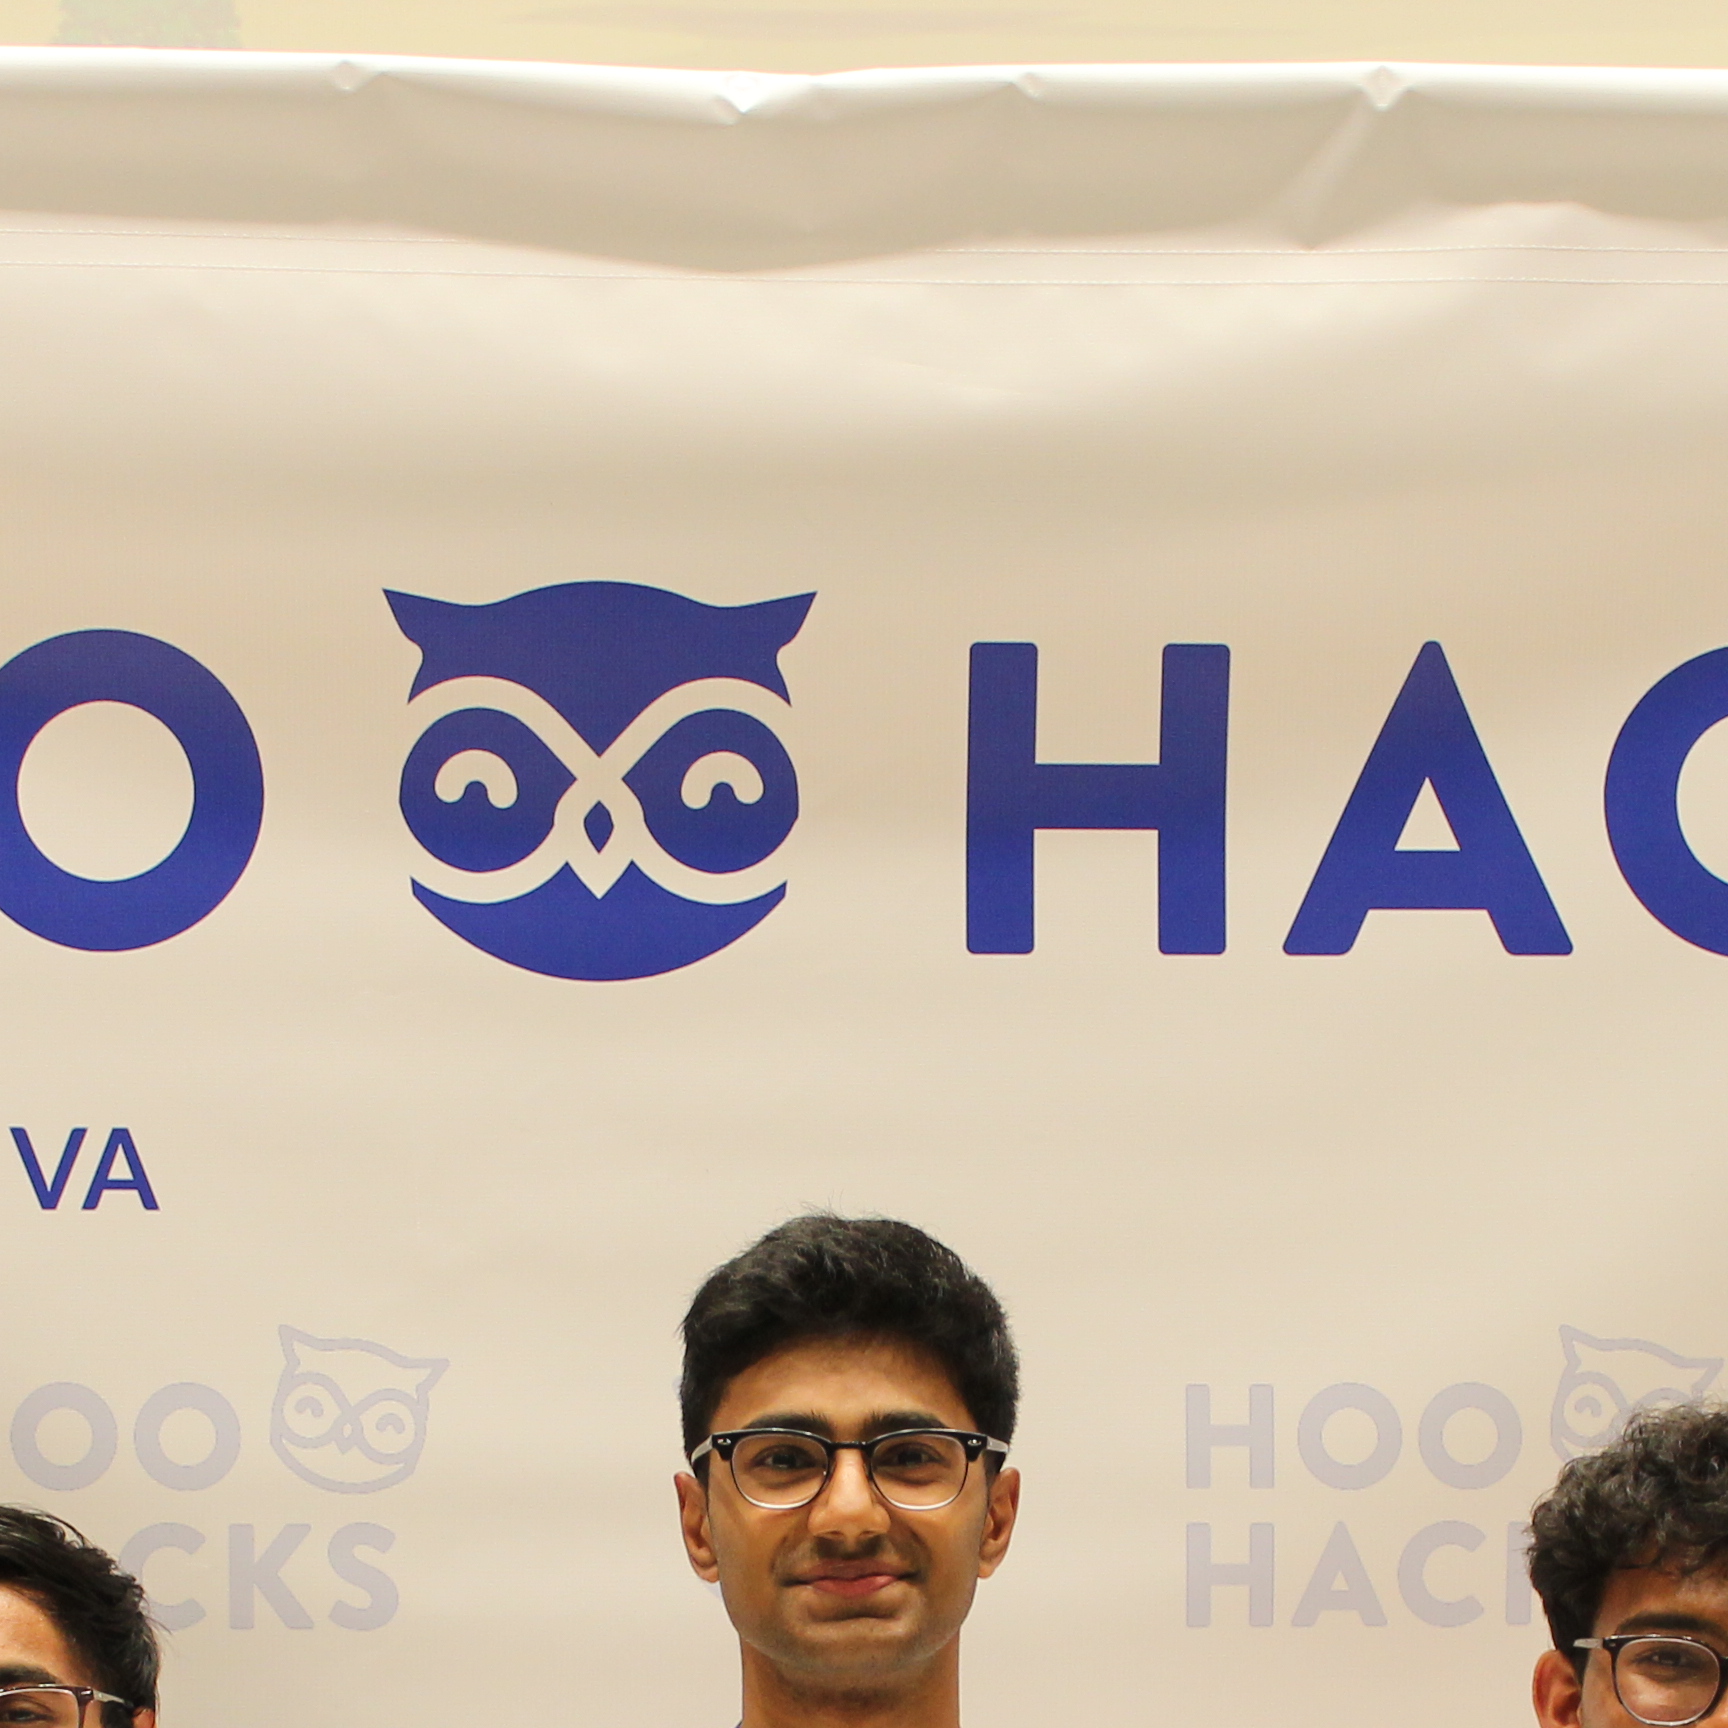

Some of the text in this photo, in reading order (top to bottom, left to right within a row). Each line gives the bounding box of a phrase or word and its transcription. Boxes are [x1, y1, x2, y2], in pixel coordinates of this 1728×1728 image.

[9, 1126, 161, 1211] VA
[1185, 1382, 1523, 1490] HOO
[120, 1522, 400, 1632] CKS
